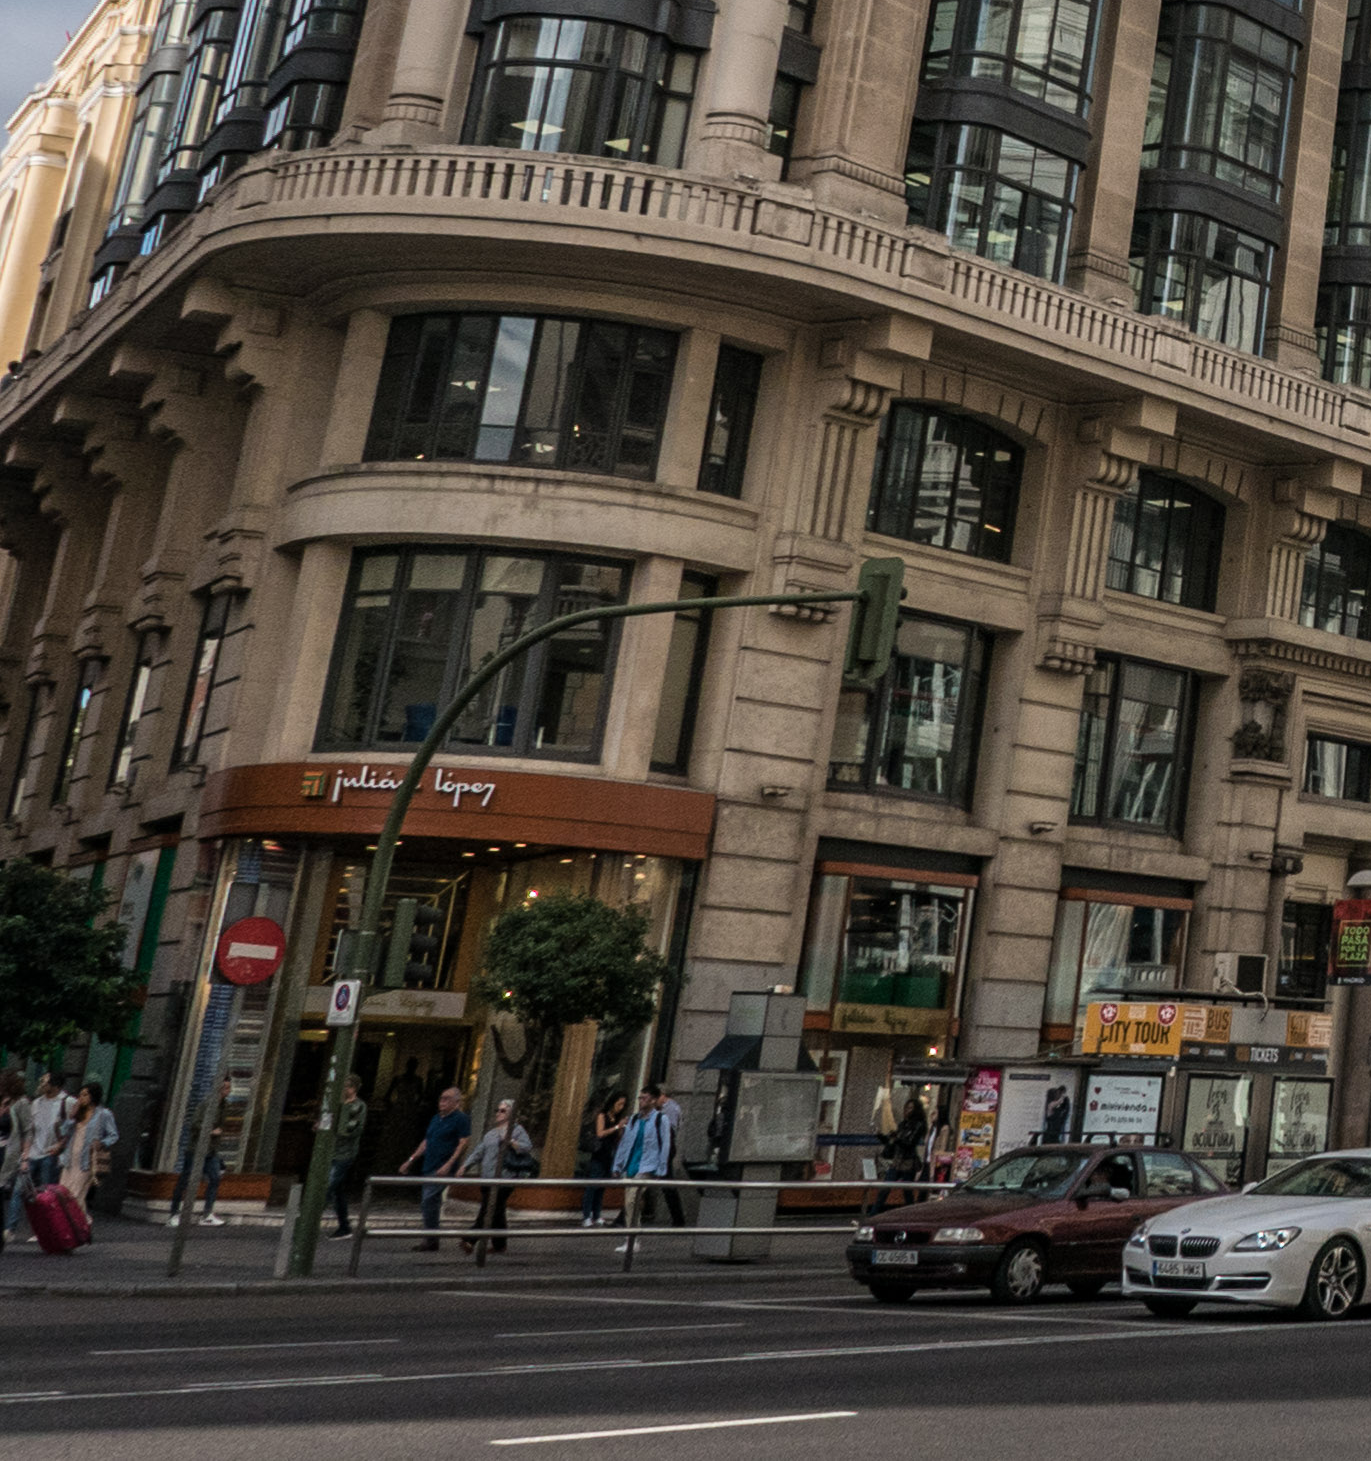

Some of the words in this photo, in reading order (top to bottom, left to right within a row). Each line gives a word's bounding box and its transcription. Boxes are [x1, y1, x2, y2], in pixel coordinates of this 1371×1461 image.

[331, 765, 422, 802] juliá
[434, 767, 496, 807] lópez
[1344, 926, 1369, 935] TODO
[1341, 935, 1369, 944] PASA
[1341, 945, 1356, 953] POR
[1340, 953, 1367, 961] PLAZA
[1207, 1006, 1229, 1031] BUS
[1100, 1021, 1131, 1044] CITY
[1135, 1022, 1170, 1044] TOUR
[1250, 1047, 1278, 1063] TICKETS
